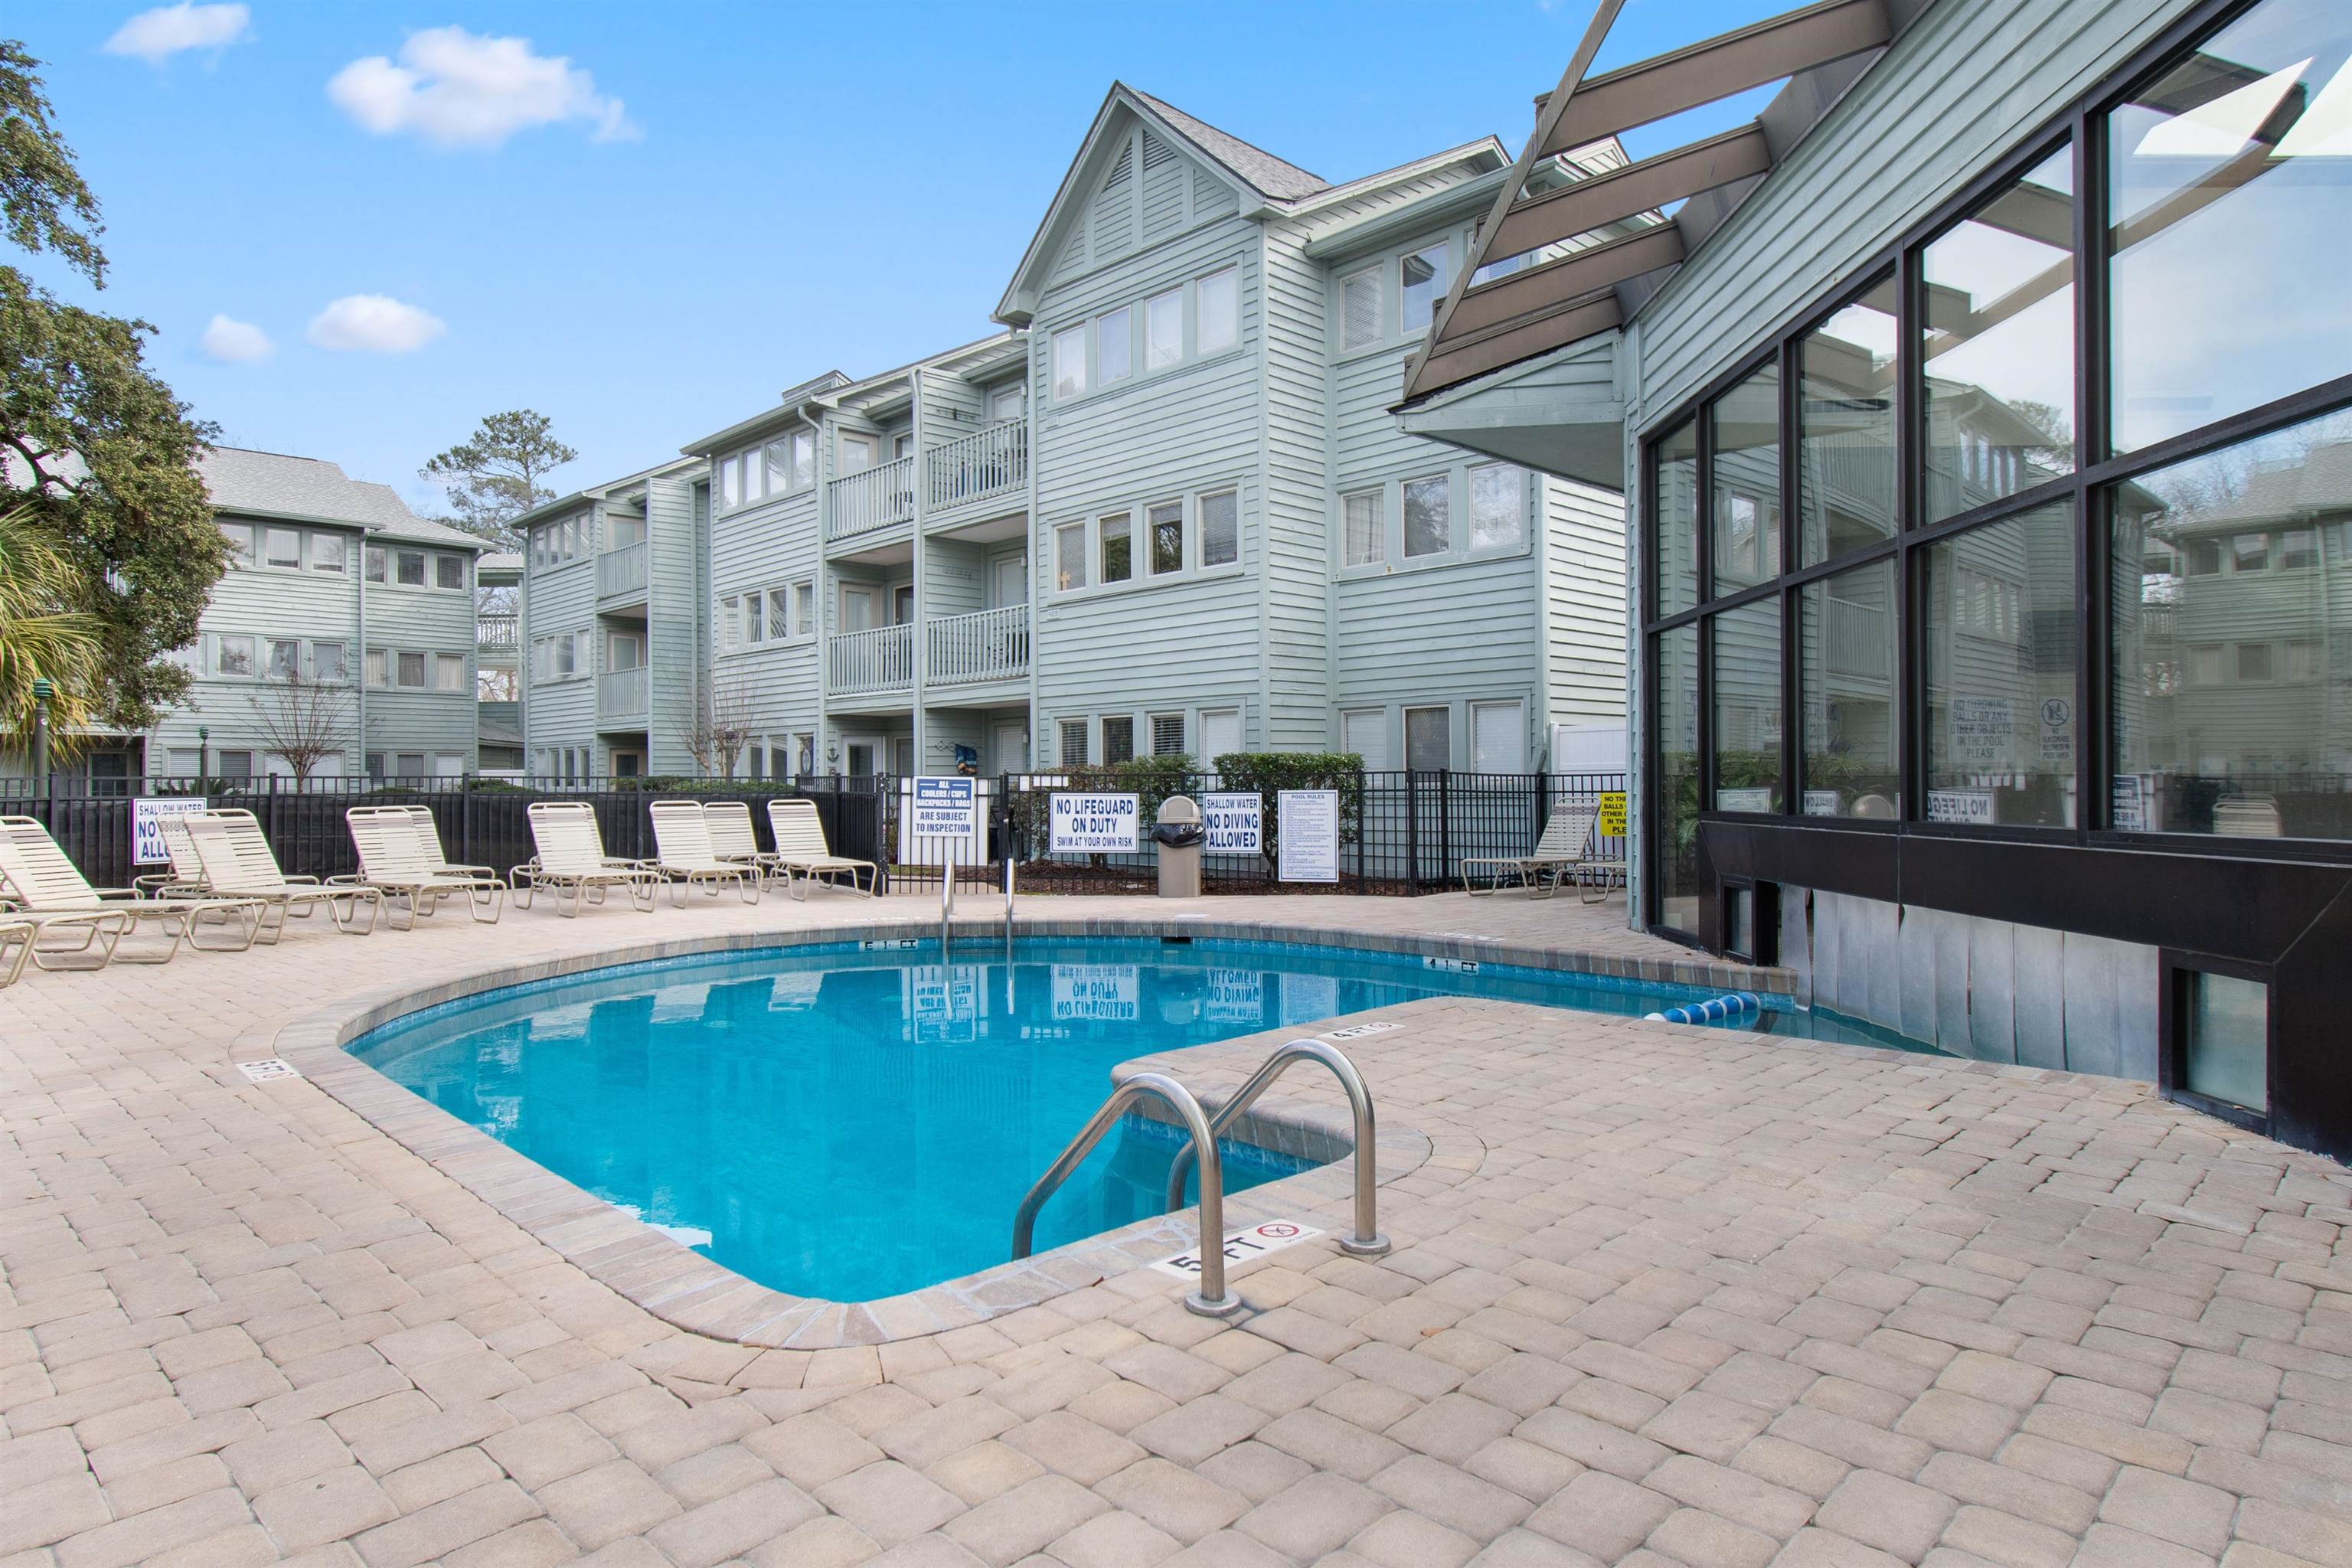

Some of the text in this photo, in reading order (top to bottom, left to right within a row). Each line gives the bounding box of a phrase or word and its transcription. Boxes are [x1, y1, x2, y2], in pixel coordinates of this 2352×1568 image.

[938, 780, 949, 789] ALL
[921, 789, 947, 798] COOLERS
[1057, 799, 1133, 815] NO LIFEGUARD
[1207, 799, 1258, 809] SHALLOW WATER
[920, 812, 968, 822] ARE SUBJECT
[1207, 813, 1259, 829] NO DIVING
[138, 821, 156, 838] NO
[916, 823, 971, 833] TO INSPECTION
[1072, 817, 1118, 833] ON DUTY
[1057, 836, 1133, 847] SWIM AT YOUR OWN RISK
[1208, 831, 1256, 848] ALLOWED
[1168, 1256, 1201, 1272] 5
